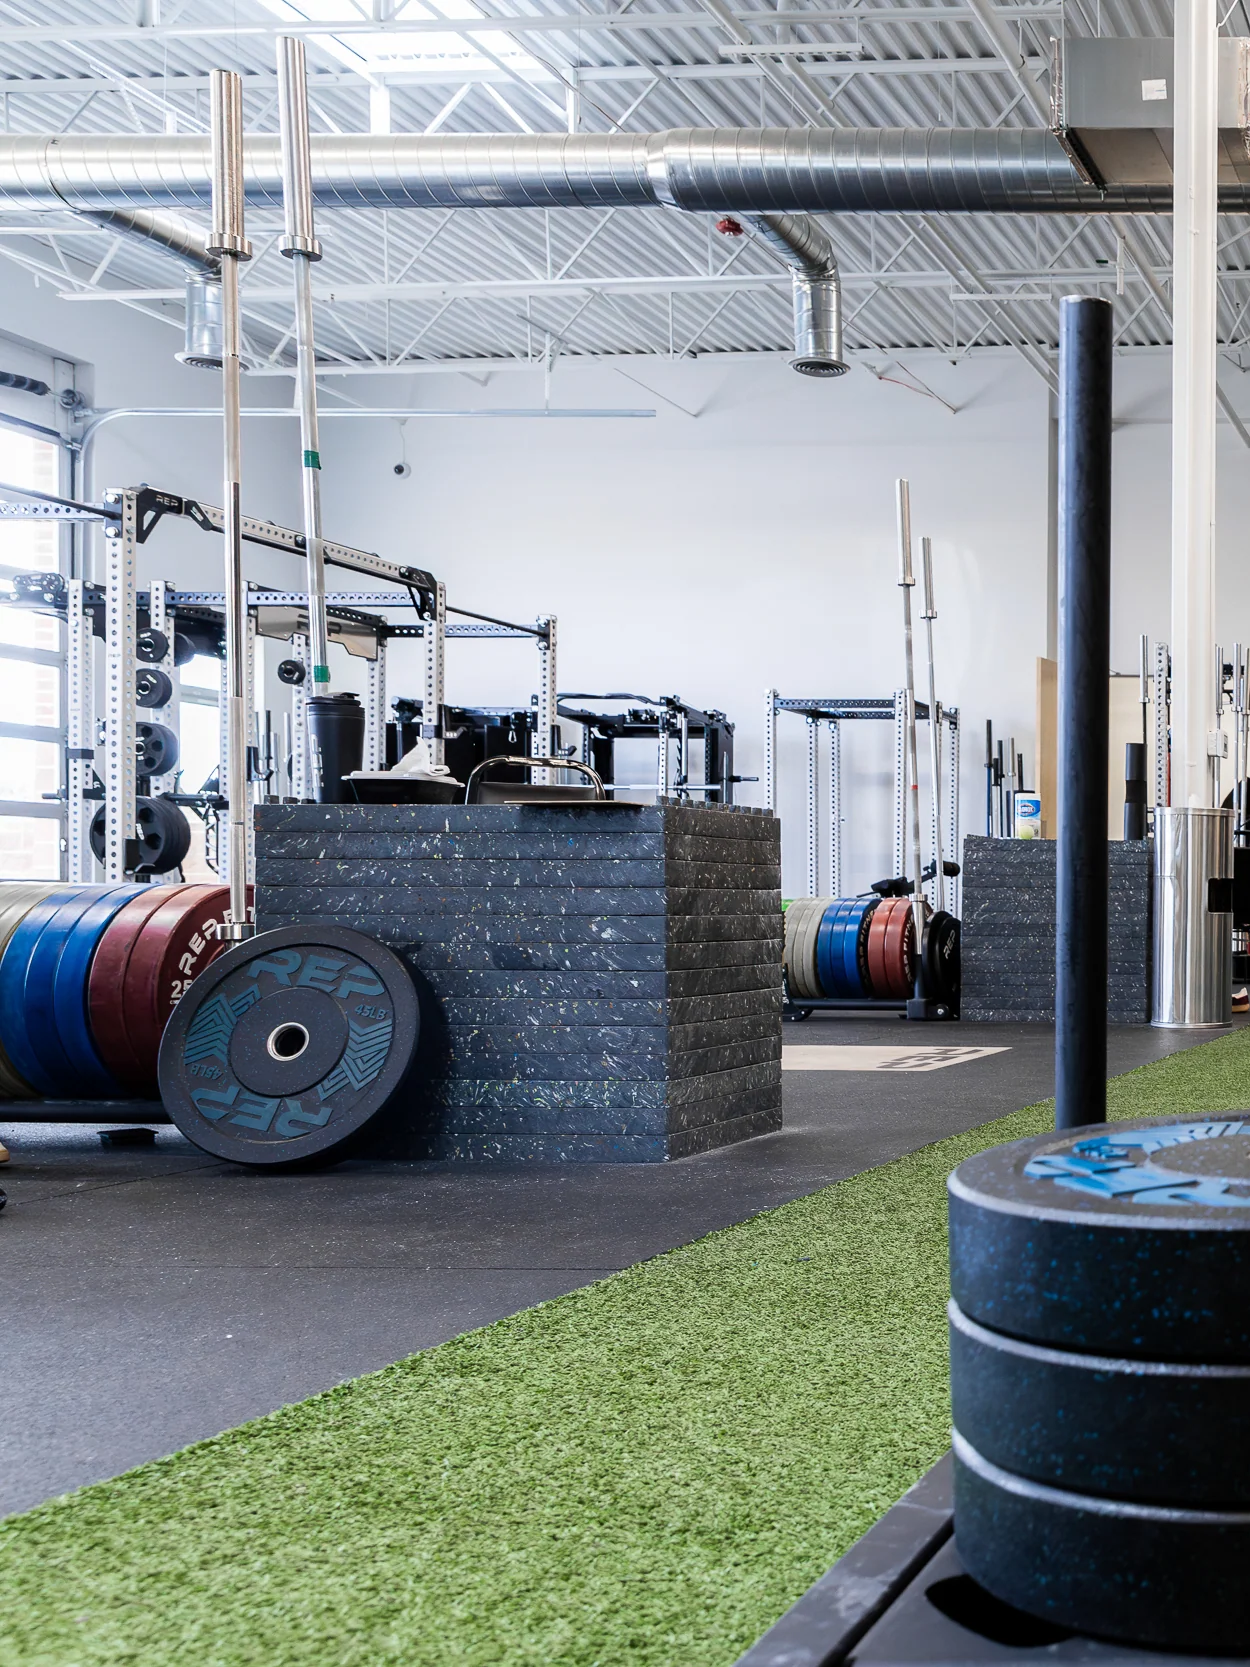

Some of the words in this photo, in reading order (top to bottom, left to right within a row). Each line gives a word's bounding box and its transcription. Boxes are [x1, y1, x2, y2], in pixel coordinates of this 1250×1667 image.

[155, 494, 179, 506] REP
[178, 918, 218, 976] REP
[943, 929, 956, 960] REP
[246, 950, 387, 999] REP
[354, 1004, 388, 1021] 45LB
[190, 1063, 224, 1080] 45LB
[190, 1085, 334, 1138] REP
